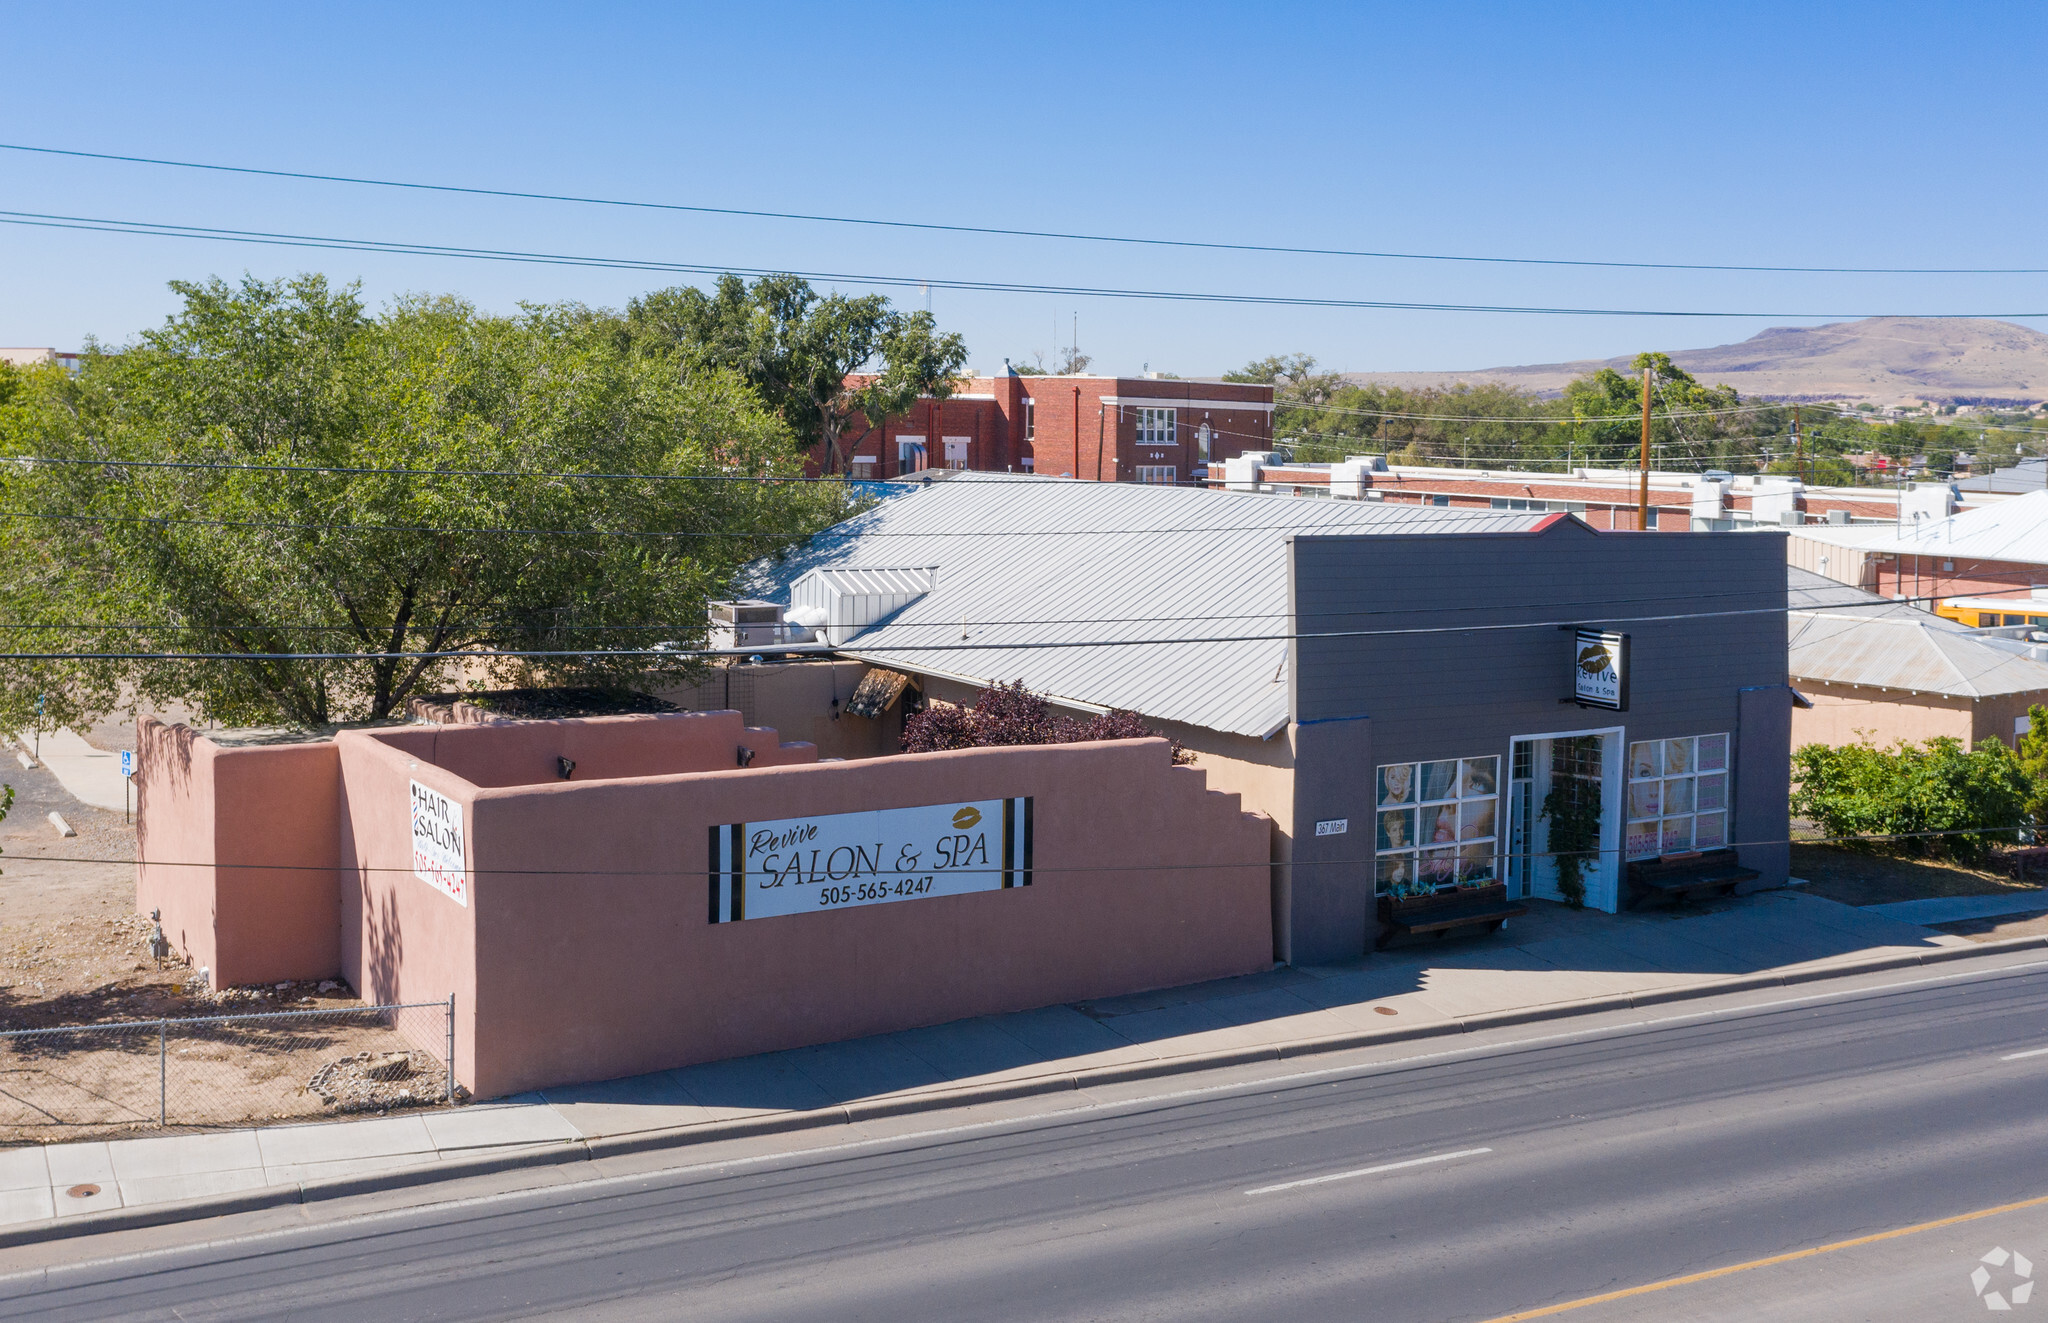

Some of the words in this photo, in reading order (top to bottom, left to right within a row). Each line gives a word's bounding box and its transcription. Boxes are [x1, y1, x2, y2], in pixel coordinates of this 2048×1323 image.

[1602, 687, 1615, 696] Spa
[418, 787, 449, 823] HAIR
[419, 815, 461, 857] SALON
[749, 824, 818, 858] Revive
[1330, 821, 1345, 833] Main
[760, 843, 883, 889] SALON
[895, 844, 923, 873] &
[933, 832, 989, 870] SPA
[819, 876, 934, 906] 505-565-4247
